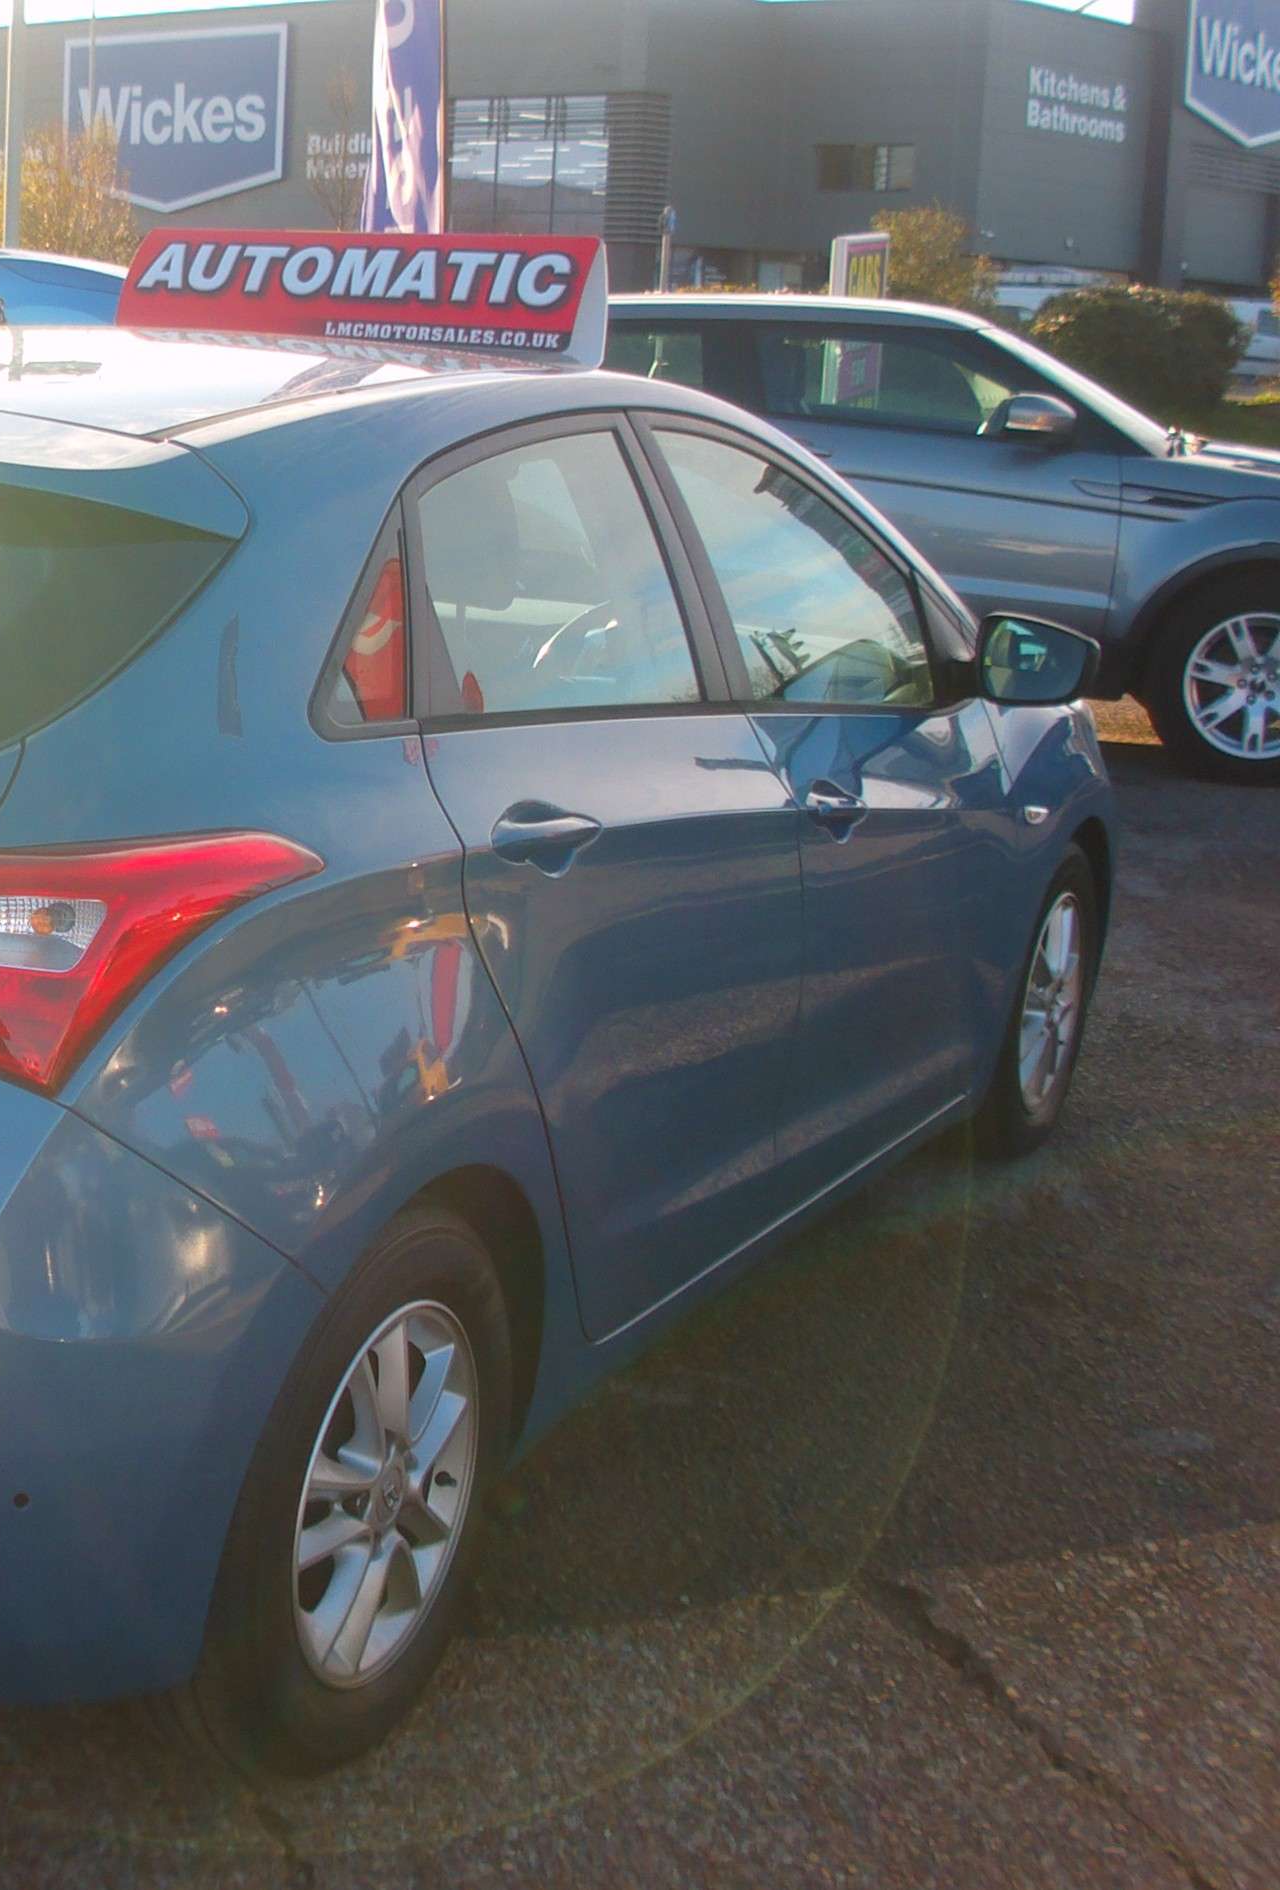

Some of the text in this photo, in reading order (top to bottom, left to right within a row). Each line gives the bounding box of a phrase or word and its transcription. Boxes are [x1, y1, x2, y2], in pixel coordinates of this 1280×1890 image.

[1027, 64, 1127, 112] Kitchens &
[78, 82, 267, 145] Wickes
[1026, 99, 1126, 143] Bathrooms
[137, 243, 572, 308] AUTOMATIC
[324, 321, 561, 349] LMCMOTORSALES.CO.UK
